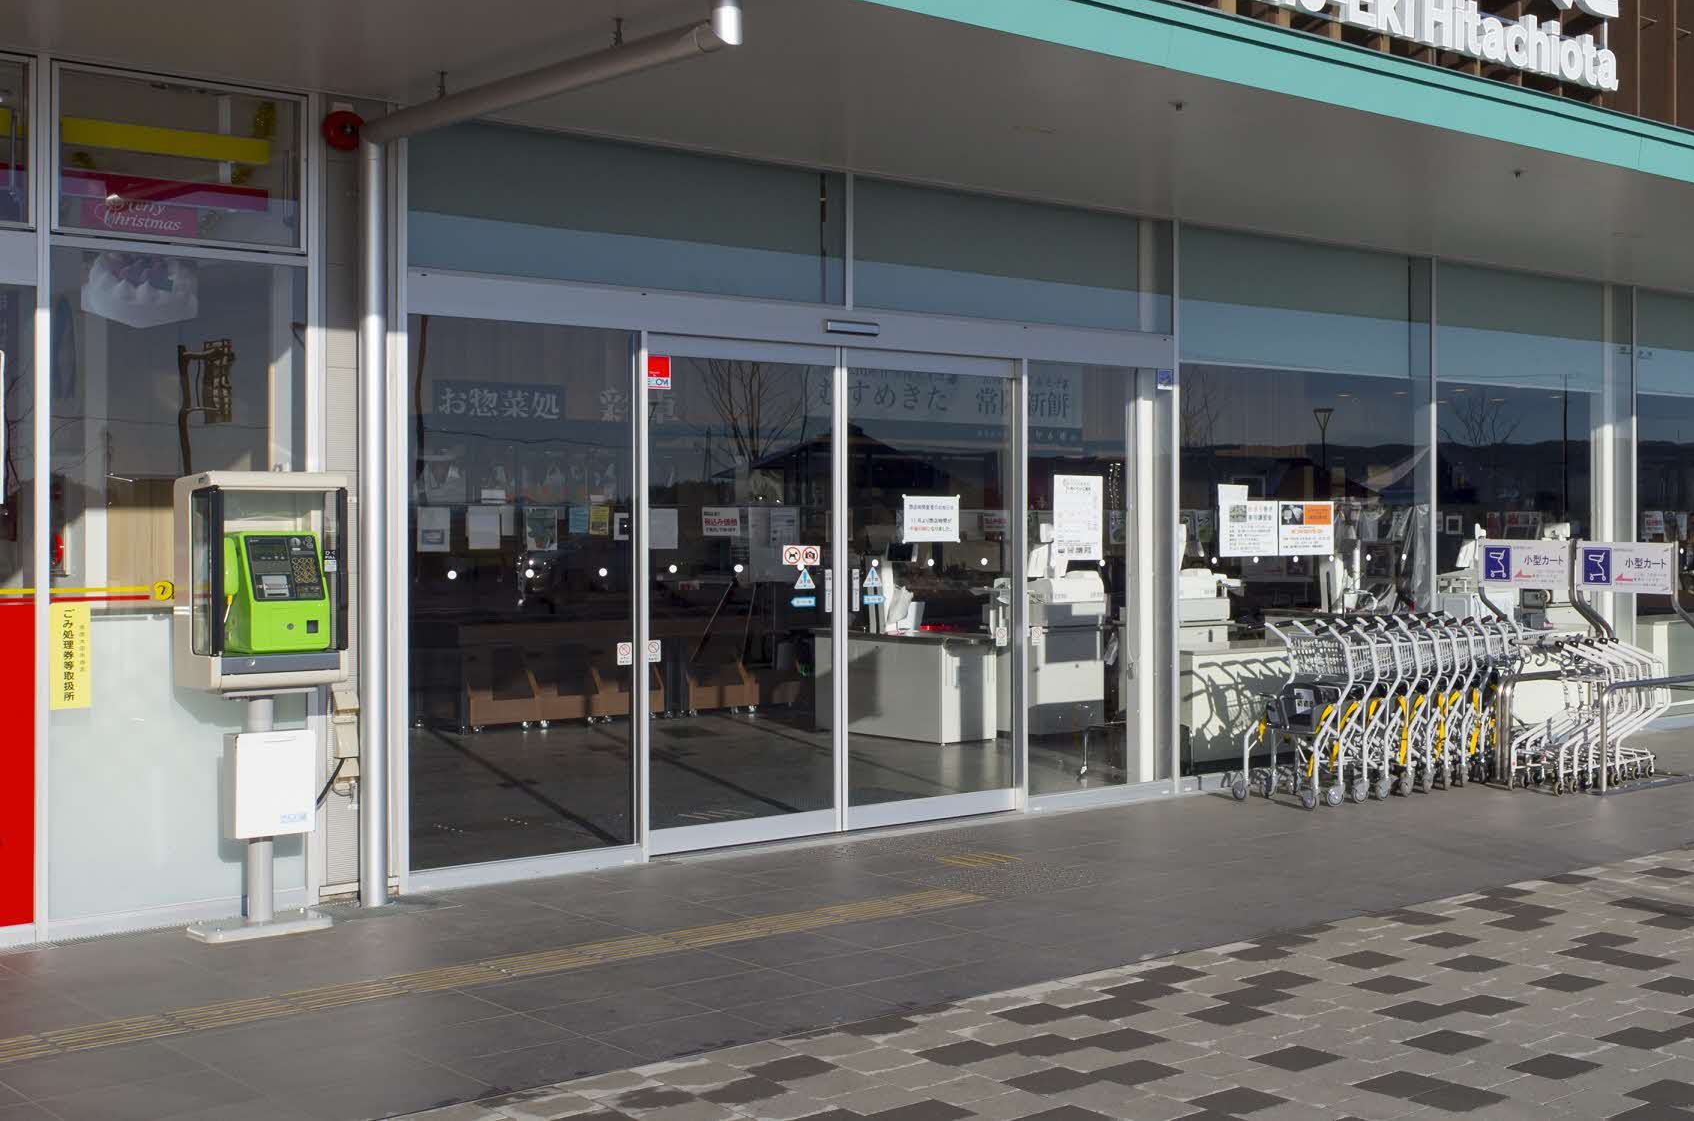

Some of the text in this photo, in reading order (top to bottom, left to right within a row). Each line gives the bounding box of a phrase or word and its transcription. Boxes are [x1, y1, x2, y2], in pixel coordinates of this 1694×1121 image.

[438, 387, 560, 420] お惣菜処
[1523, 554, 1564, 566] 小型カート
[1625, 557, 1667, 569] 小型カート
[62, 608, 75, 702] ごみ処理券等取扱所
